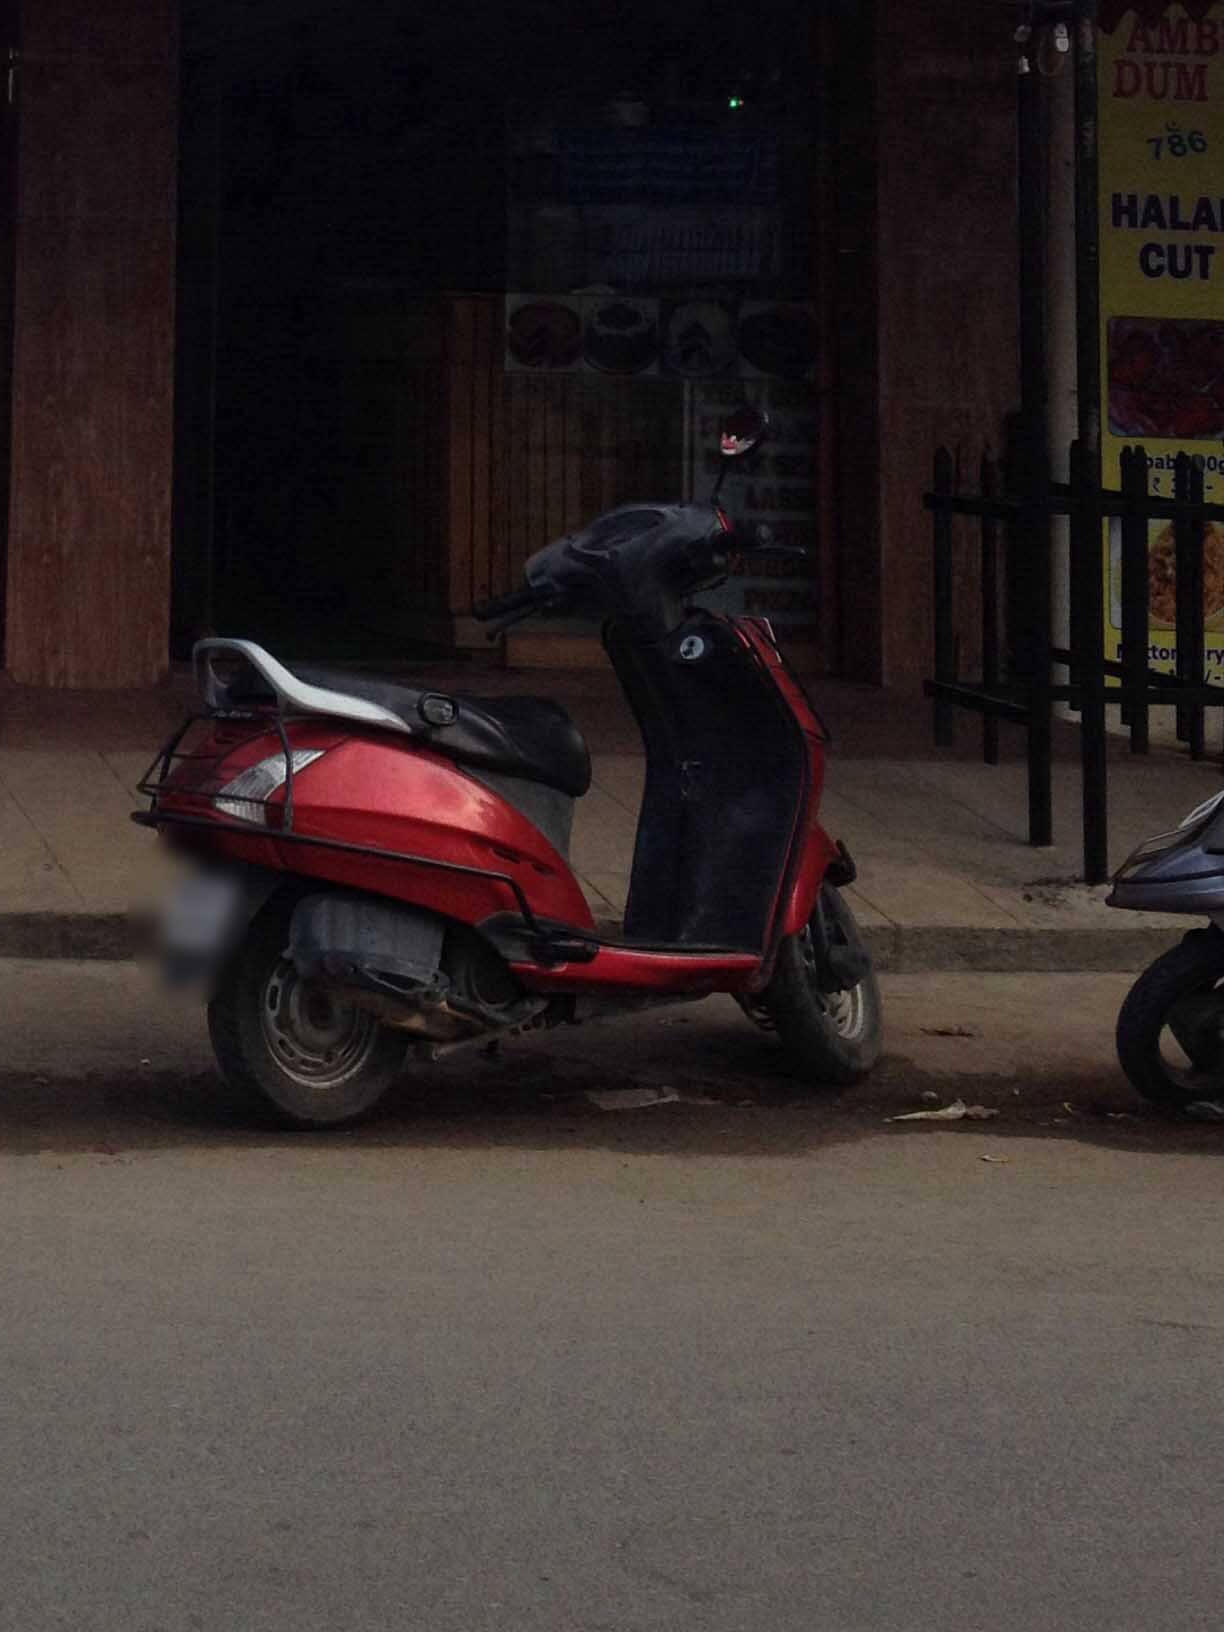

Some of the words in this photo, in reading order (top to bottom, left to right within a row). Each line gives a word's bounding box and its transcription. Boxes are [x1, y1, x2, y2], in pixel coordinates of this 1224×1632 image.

[1127, 18, 1224, 55] AMB
[1112, 60, 1208, 101] DUM
[1146, 130, 1208, 160] 786
[1112, 192, 1224, 232] HALA
[1140, 242, 1215, 280] CUT
